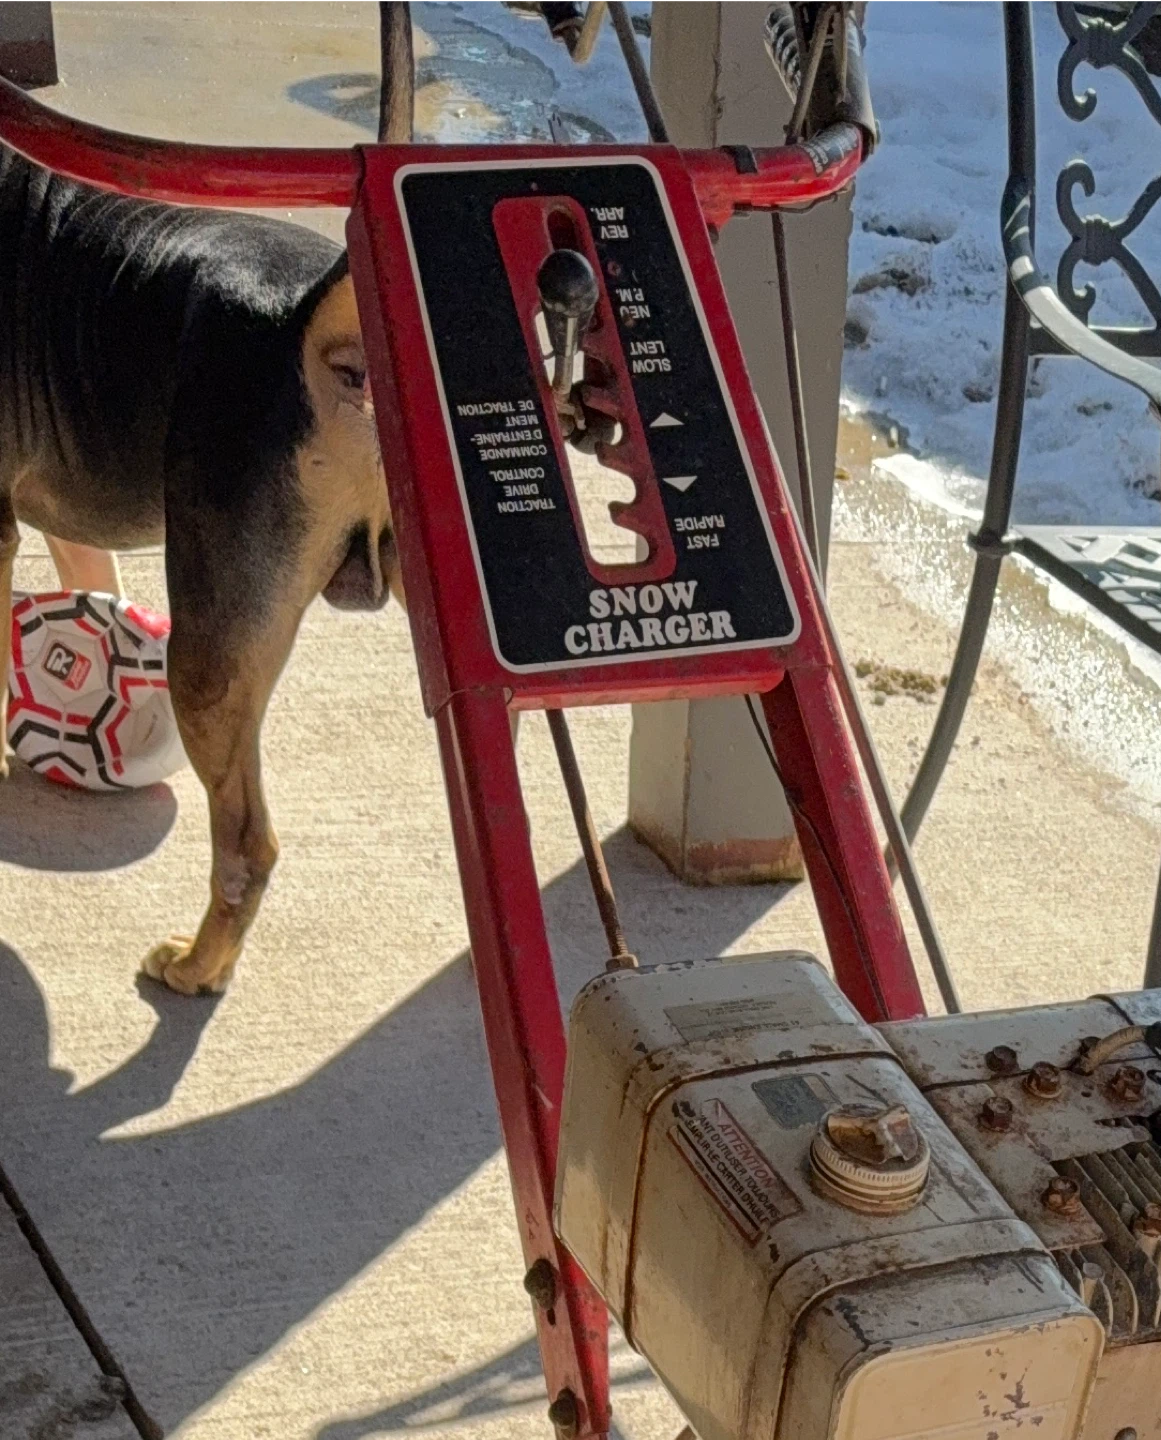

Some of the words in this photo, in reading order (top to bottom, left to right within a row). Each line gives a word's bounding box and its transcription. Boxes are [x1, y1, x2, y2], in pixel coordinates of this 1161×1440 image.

[590, 207, 624, 220] ARR.
[600, 225, 629, 238] REV
[616, 289, 644, 301] P.M.
[630, 341, 665, 354] LENT
[633, 358, 671, 372] SLOW
[457, 401, 517, 416] TRACTION
[521, 400, 534, 410] DE
[506, 415, 538, 426] MENT
[480, 445, 547, 459] COMMANDE
[489, 467, 545, 481] CONTROL
[504, 483, 539, 496] DRIVE
[498, 499, 556, 513] TRACTION
[675, 515, 725, 530] RAPIDE
[687, 533, 720, 549] FAST
[589, 581, 698, 619] SNOW
[564, 610, 736, 654] CHARGER
[717, 1119, 776, 1190] ATTENTION
[705, 1147, 720, 1163] LE
[715, 1160, 745, 1195] CARTER
[743, 1174, 780, 1219] TOUJOURS
